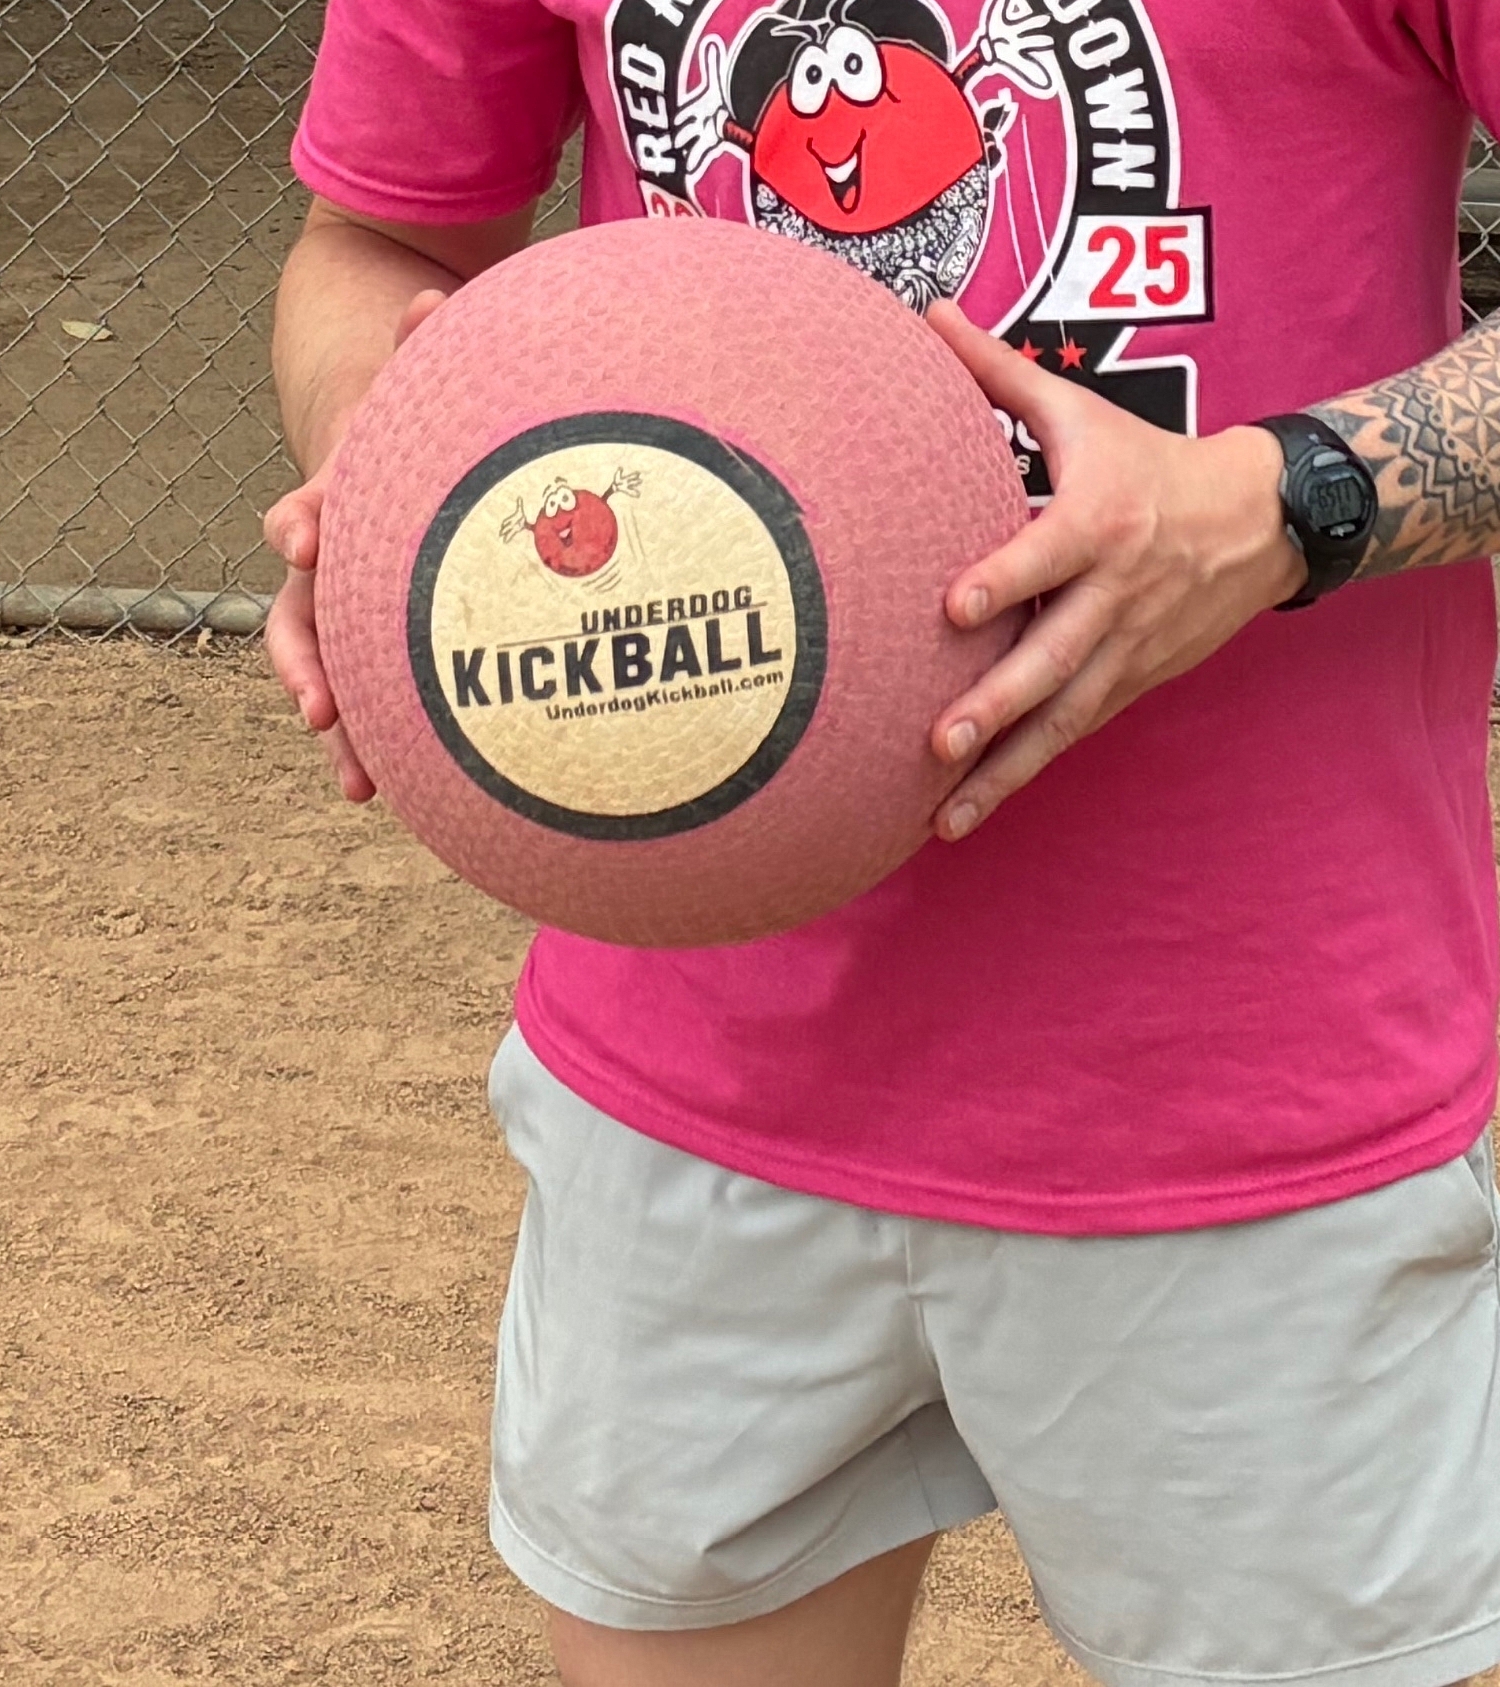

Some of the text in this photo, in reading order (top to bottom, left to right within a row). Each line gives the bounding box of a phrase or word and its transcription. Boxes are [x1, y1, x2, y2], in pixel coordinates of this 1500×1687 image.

[621, 43, 676, 177] RED
[1087, 225, 1190, 307] 25
[581, 585, 752, 634] UNDERDOG
[451, 610, 782, 708] KICKBALL
[545, 670, 784, 720] UnderdogKickball.com
